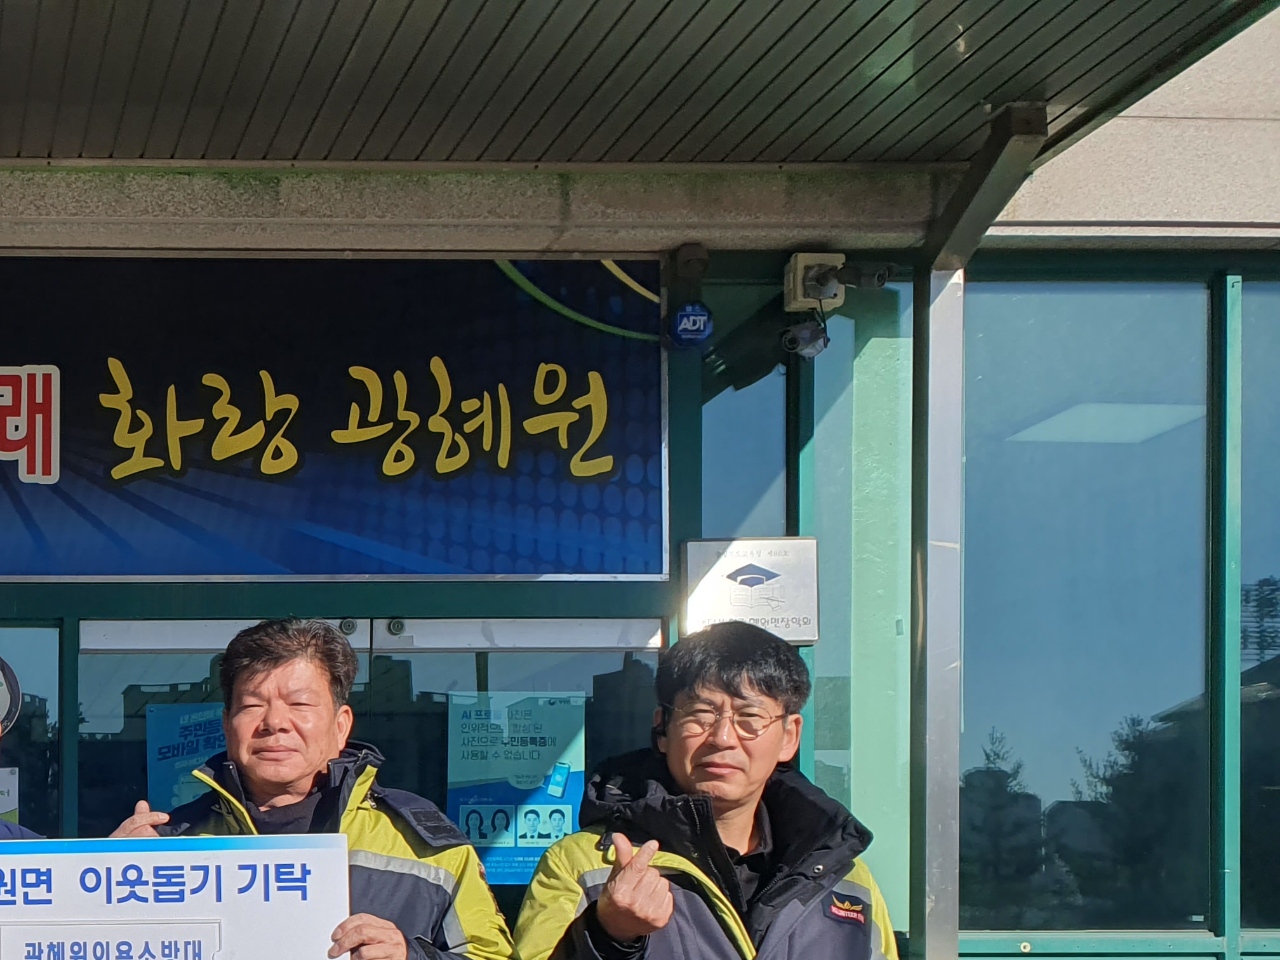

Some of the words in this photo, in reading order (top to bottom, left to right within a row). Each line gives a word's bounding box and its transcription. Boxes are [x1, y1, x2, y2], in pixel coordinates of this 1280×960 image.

[678, 315, 708, 331] ADT
[98, 356, 300, 480] 화랑
[330, 356, 614, 478] 광혜원
[461, 710, 472, 720] AI
[157, 738, 200, 761] 모바일
[491, 750, 501, 760] 수
[504, 750, 541, 761] 없습니다
[78, 864, 223, 904] 이웃돕기
[236, 863, 312, 902] 기탁
